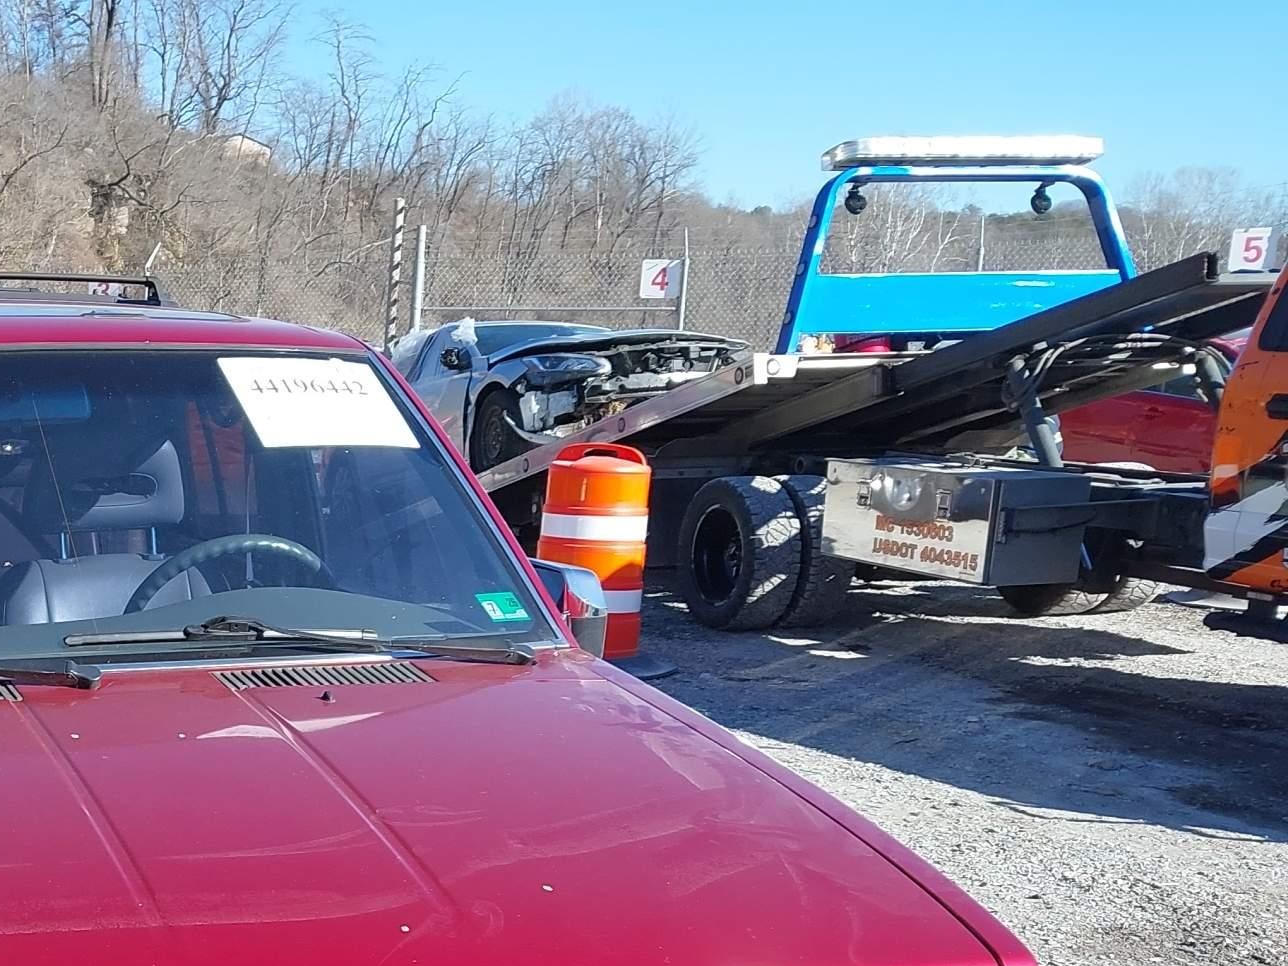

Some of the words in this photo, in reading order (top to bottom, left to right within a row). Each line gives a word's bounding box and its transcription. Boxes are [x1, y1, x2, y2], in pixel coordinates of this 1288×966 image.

[1243, 236, 1263, 263] 5
[651, 267, 669, 290] 4
[250, 378, 368, 396] 44196442
[875, 515, 895, 533] MC
[872, 536, 918, 560] USDOT
